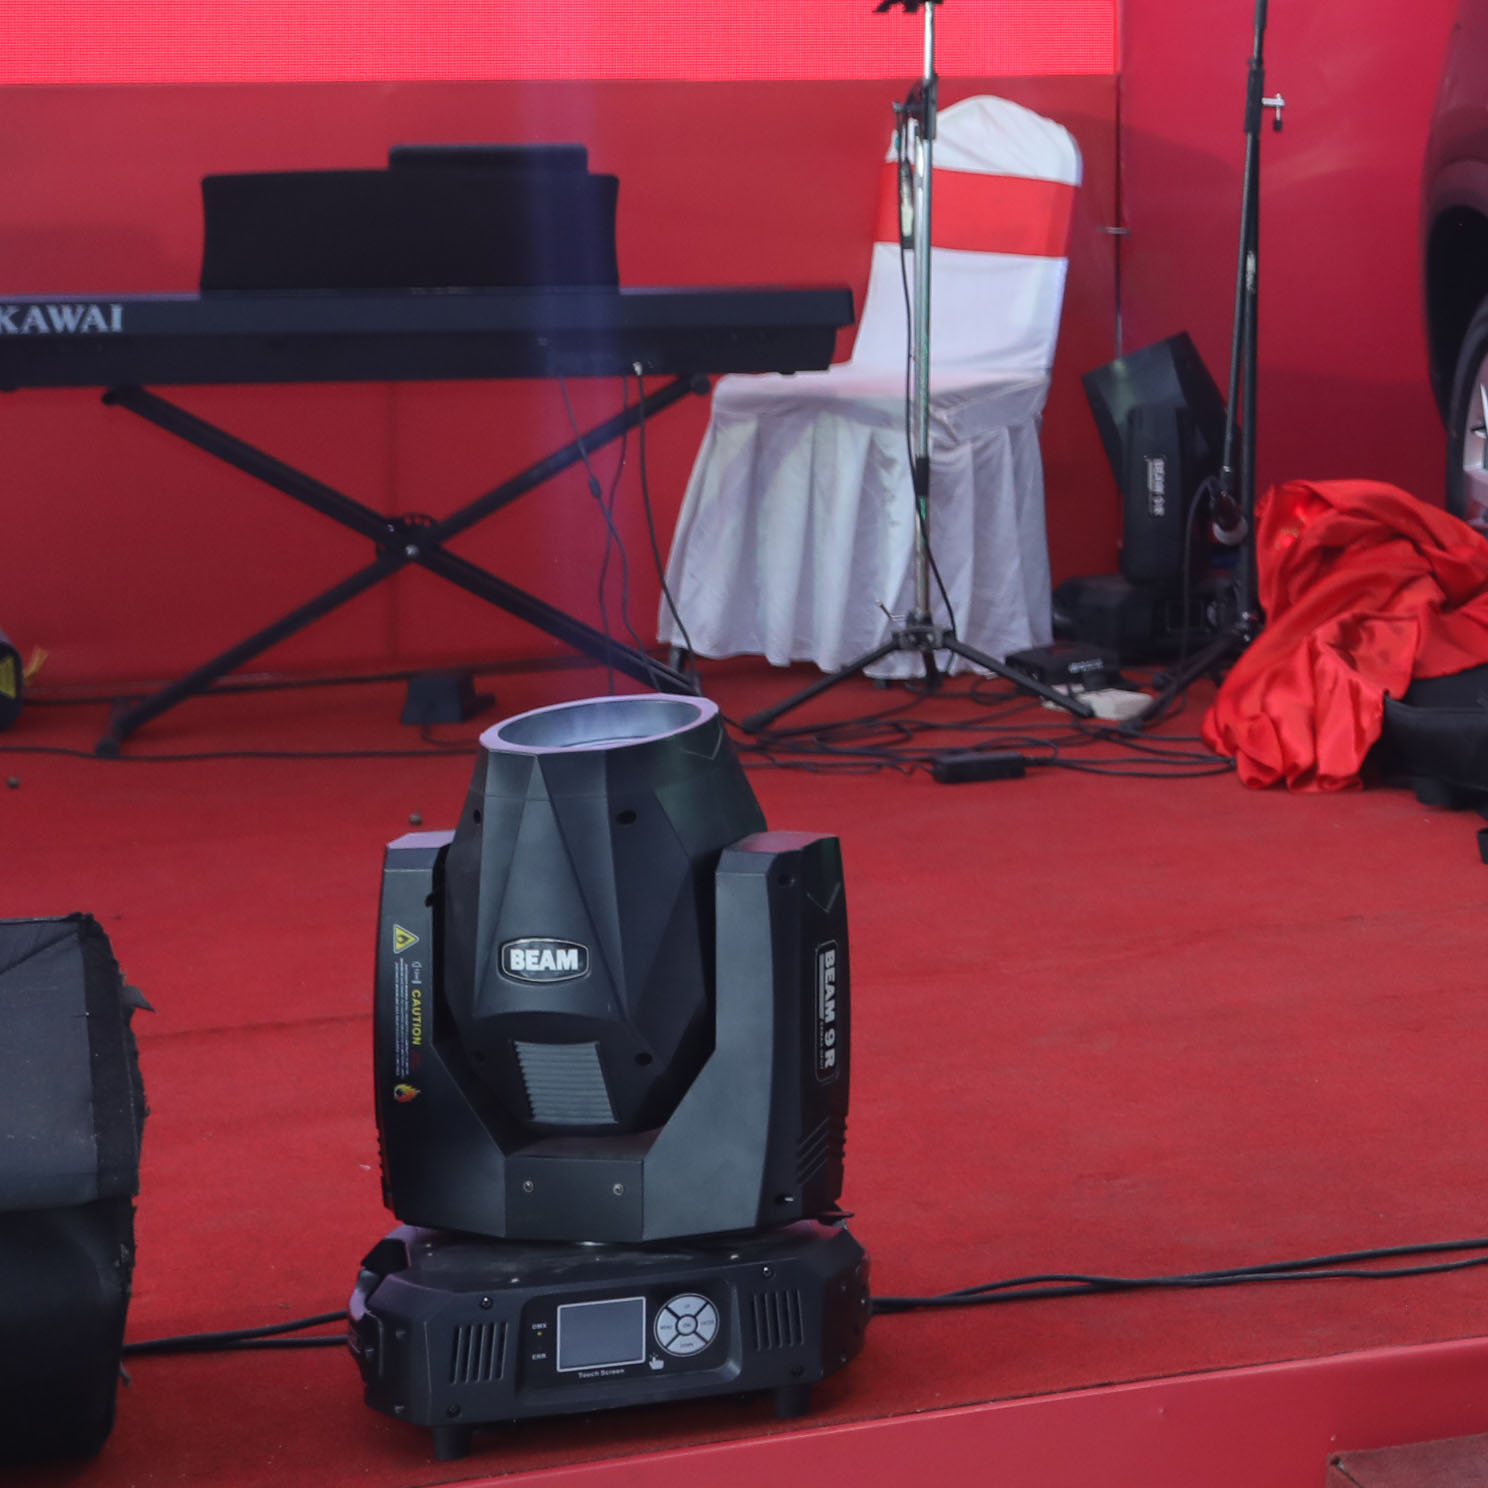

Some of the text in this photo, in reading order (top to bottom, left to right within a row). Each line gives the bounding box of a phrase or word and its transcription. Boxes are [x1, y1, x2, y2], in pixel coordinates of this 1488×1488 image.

[509, 948, 579, 971] BEAM
[824, 949, 836, 1023] BEAM
[411, 988, 422, 1046] CAUTION
